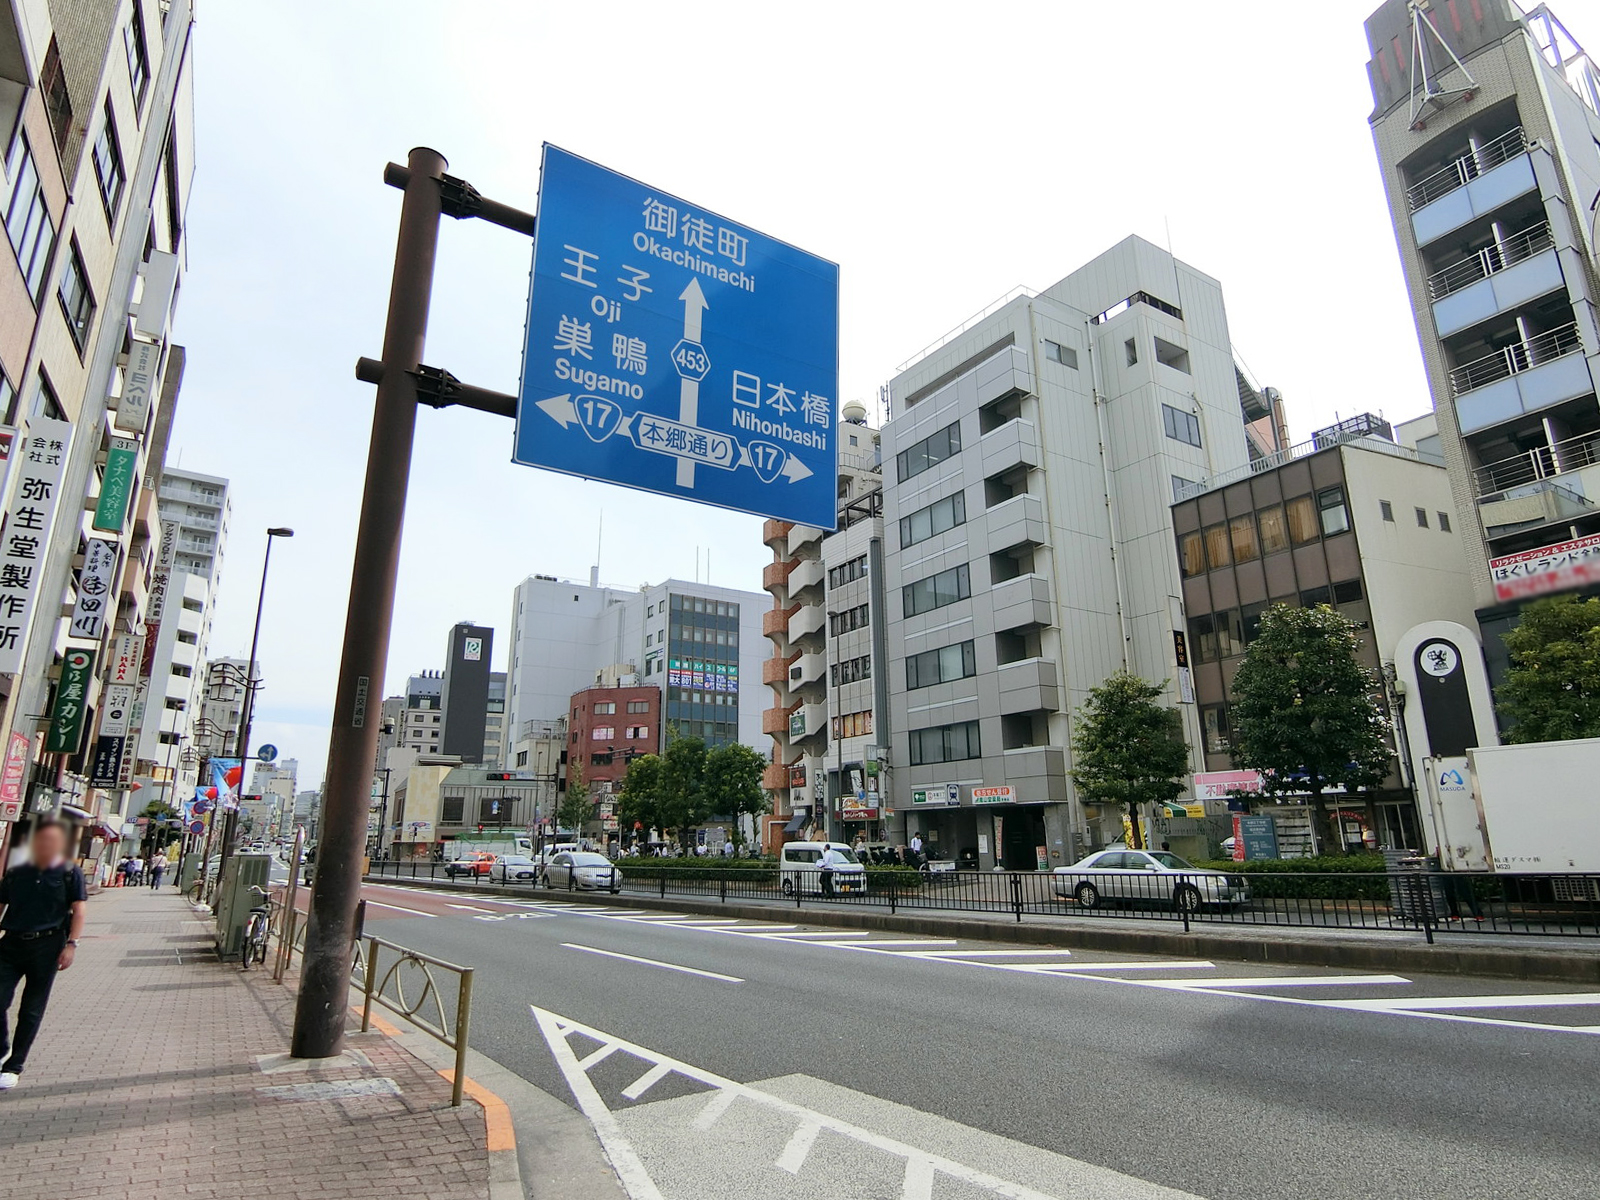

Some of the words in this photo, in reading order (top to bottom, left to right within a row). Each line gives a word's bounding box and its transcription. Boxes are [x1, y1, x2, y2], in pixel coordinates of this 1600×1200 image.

[642, 197, 749, 267] 御徒町
[560, 244, 653, 301] 王子
[633, 232, 755, 293] Okachimachi
[591, 295, 621, 323] Oji
[553, 315, 648, 377] 巣鴨
[675, 348, 706, 373] 453
[554, 358, 643, 401] Sugamo
[732, 370, 831, 430] 日本橋
[583, 401, 612, 428] 17
[732, 407, 827, 451] Nihonbashi
[116, 439, 134, 451] 3F
[641, 423, 729, 461] 本郷通り
[754, 445, 777, 471] 17
[0, 477, 53, 650] 弥生堂製作所
[1496, 550, 1550, 567] リラクゼーション
